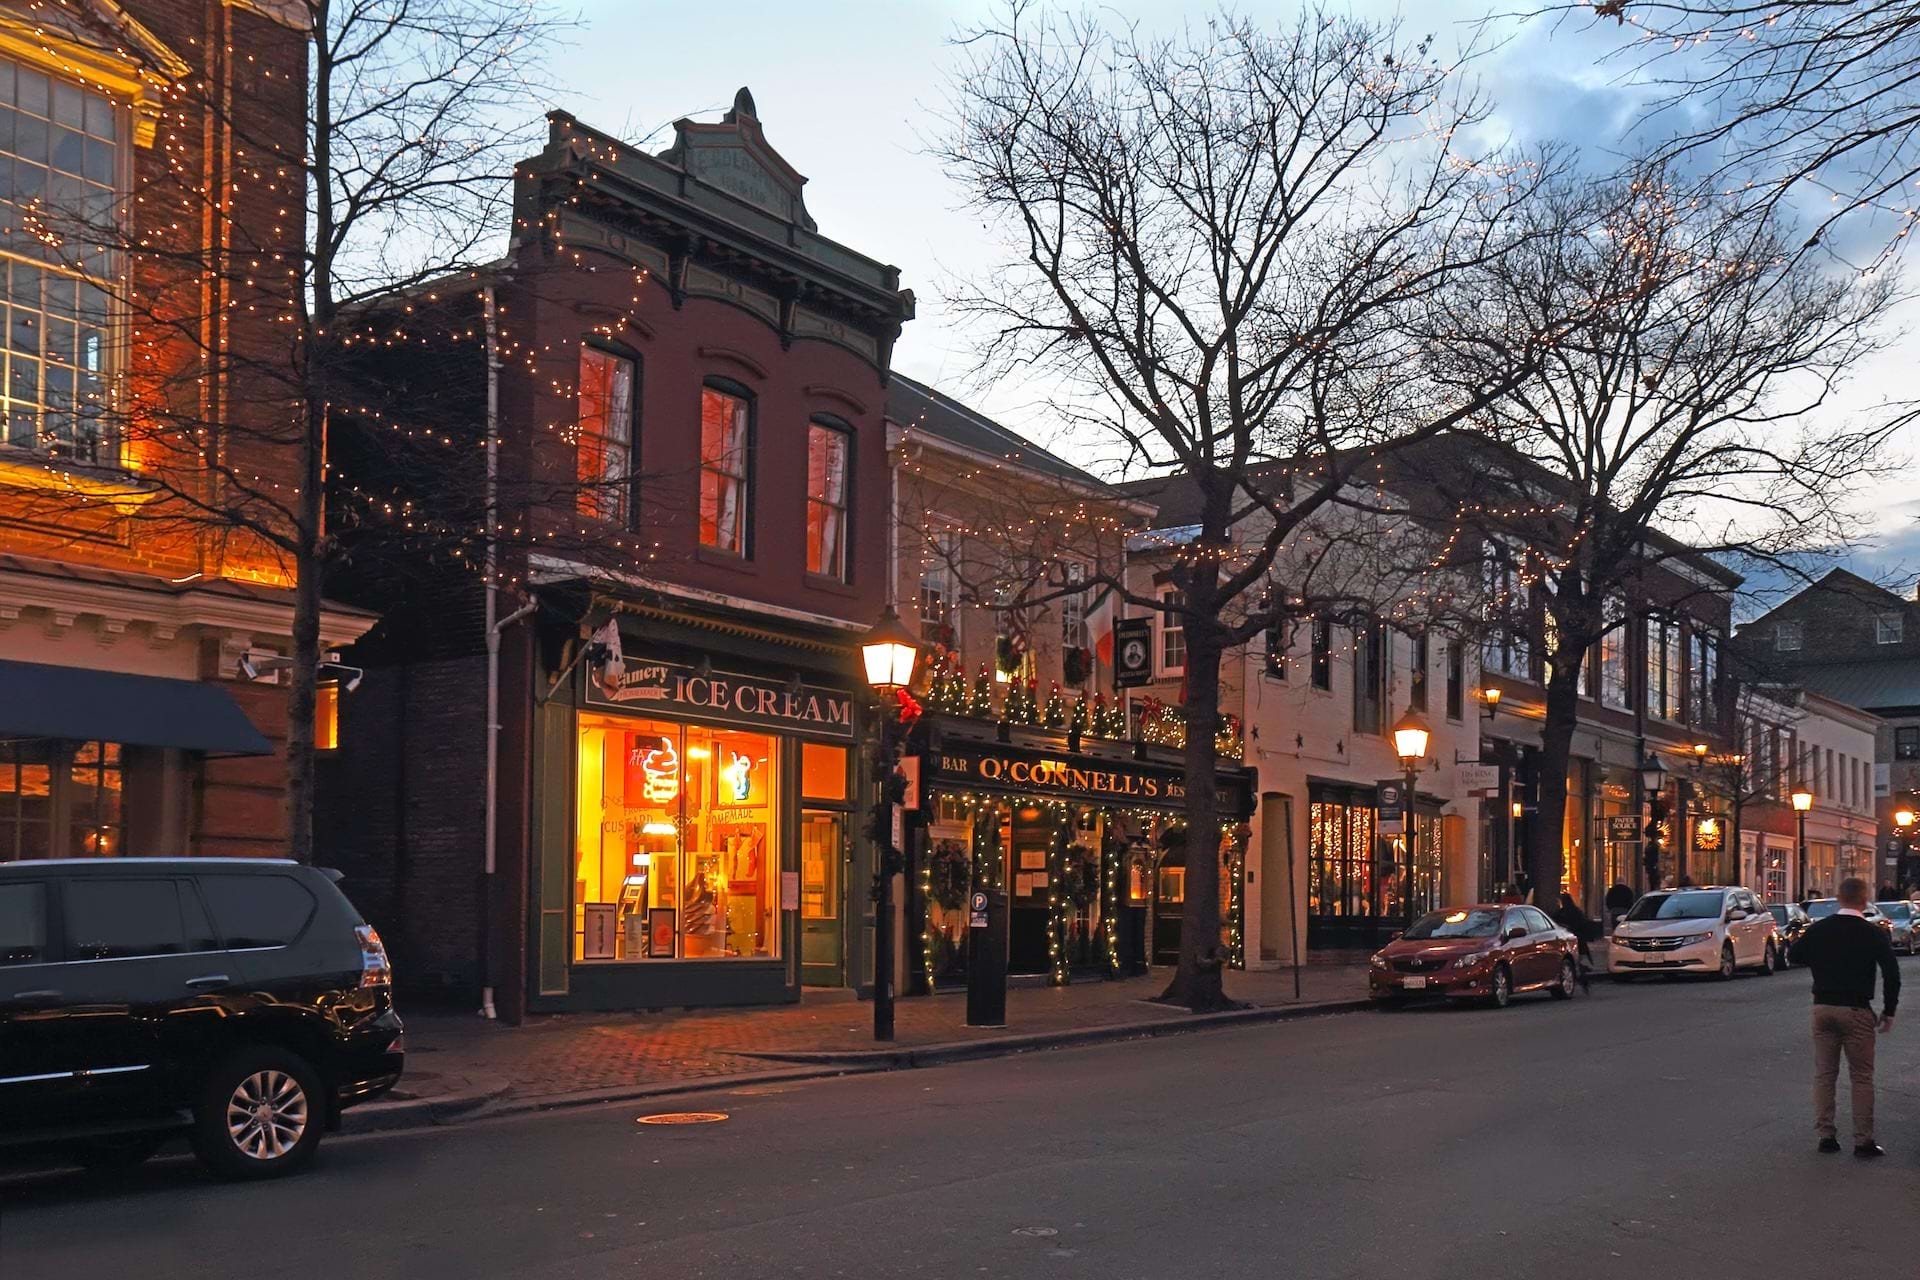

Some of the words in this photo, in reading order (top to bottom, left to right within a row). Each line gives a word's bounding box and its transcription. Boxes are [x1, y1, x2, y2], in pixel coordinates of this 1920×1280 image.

[673, 675, 730, 711] ICE
[734, 685, 851, 725] CREAM
[942, 756, 968, 772] BAR
[979, 758, 1158, 797] O'CONNELL'S
[975, 895, 983, 908] P
